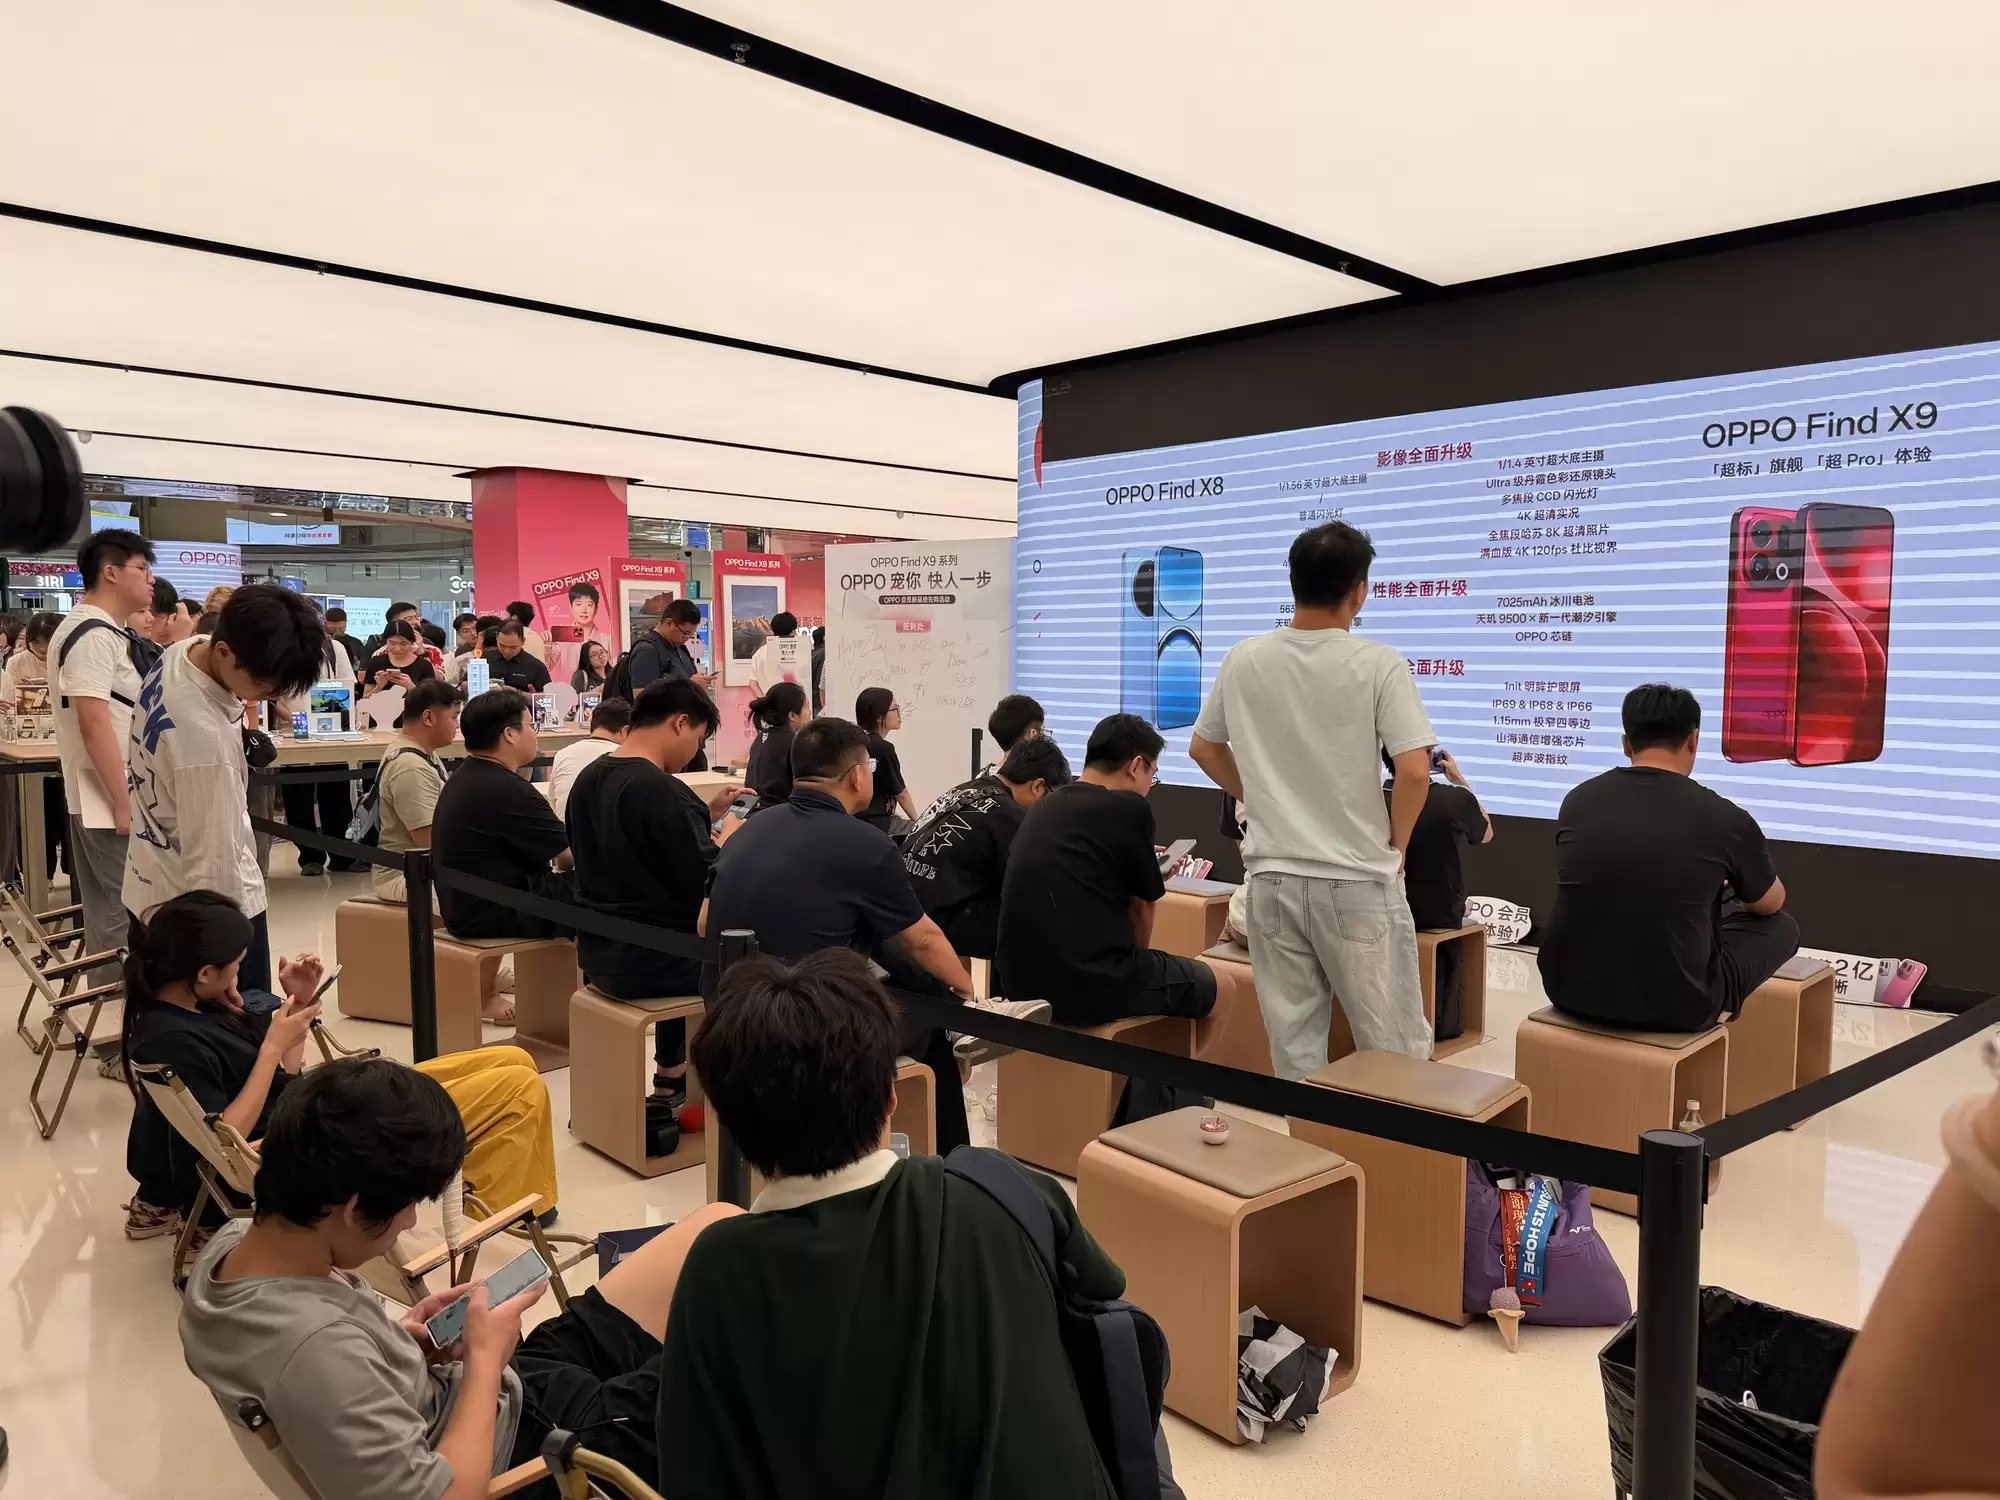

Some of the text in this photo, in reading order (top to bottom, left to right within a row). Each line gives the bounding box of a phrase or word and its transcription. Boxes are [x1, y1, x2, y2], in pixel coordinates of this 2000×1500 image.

[1702, 401, 1938, 449] OPPO Find X9
[1376, 442, 1472, 468] 影像全面升级
[1498, 449, 1605, 470] 1/1.4 英寸超大底主摄
[1278, 473, 1368, 492] 1/1.56 英寸超大底主摄
[1486, 468, 1616, 489] Ultra 级丹霞色彩还原镜头
[1106, 476, 1224, 505] OPPO Find X8
[1501, 487, 1598, 506] 多焦段 CCD 闪光灯
[1299, 508, 1343, 521] 普通闪光灯
[1517, 507, 1580, 521] 4K 超清实况
[1488, 523, 1610, 542] 全焦段哈苏 8K 超清照片
[1480, 541, 1618, 559] 满血版 4K 120fps 杜比视界
[179, 550, 226, 567] OPPO
[724, 558, 744, 566] OPPO
[744, 559, 758, 567] Find
[758, 560, 767, 568] X9
[870, 554, 958, 568] OPPO Find X9 系列
[621, 564, 640, 572] OPPO
[640, 565, 653, 573] Find
[654, 566, 662, 574] X9
[534, 579, 564, 595] OPPO
[564, 573, 586, 587] Find
[585, 570, 600, 582] X9
[840, 570, 992, 591] OPPO 宠你 快人一步
[1373, 580, 1467, 599] 性能全面升级
[1497, 595, 1595, 607] 7025mAh 冰川电池
[1476, 613, 1496, 625] 天玑
[1499, 613, 1527, 624] 9500
[1538, 611, 1617, 623] 新一代潮汐引擎
[902, 622, 925, 631] 签到处
[1515, 631, 1572, 642] OPPO 芯链
[1504, 681, 1581, 693] 1nit 明眸护眼屏
[1492, 699, 1593, 712] IP69 & IP68 & IP66
[1493, 715, 1591, 730] 1.15mm 极窄四等边
[1496, 732, 1586, 748] 山海通信增强芯片
[1511, 751, 1568, 766] 超声波指纹
[1498, 905, 1529, 924] 会员
